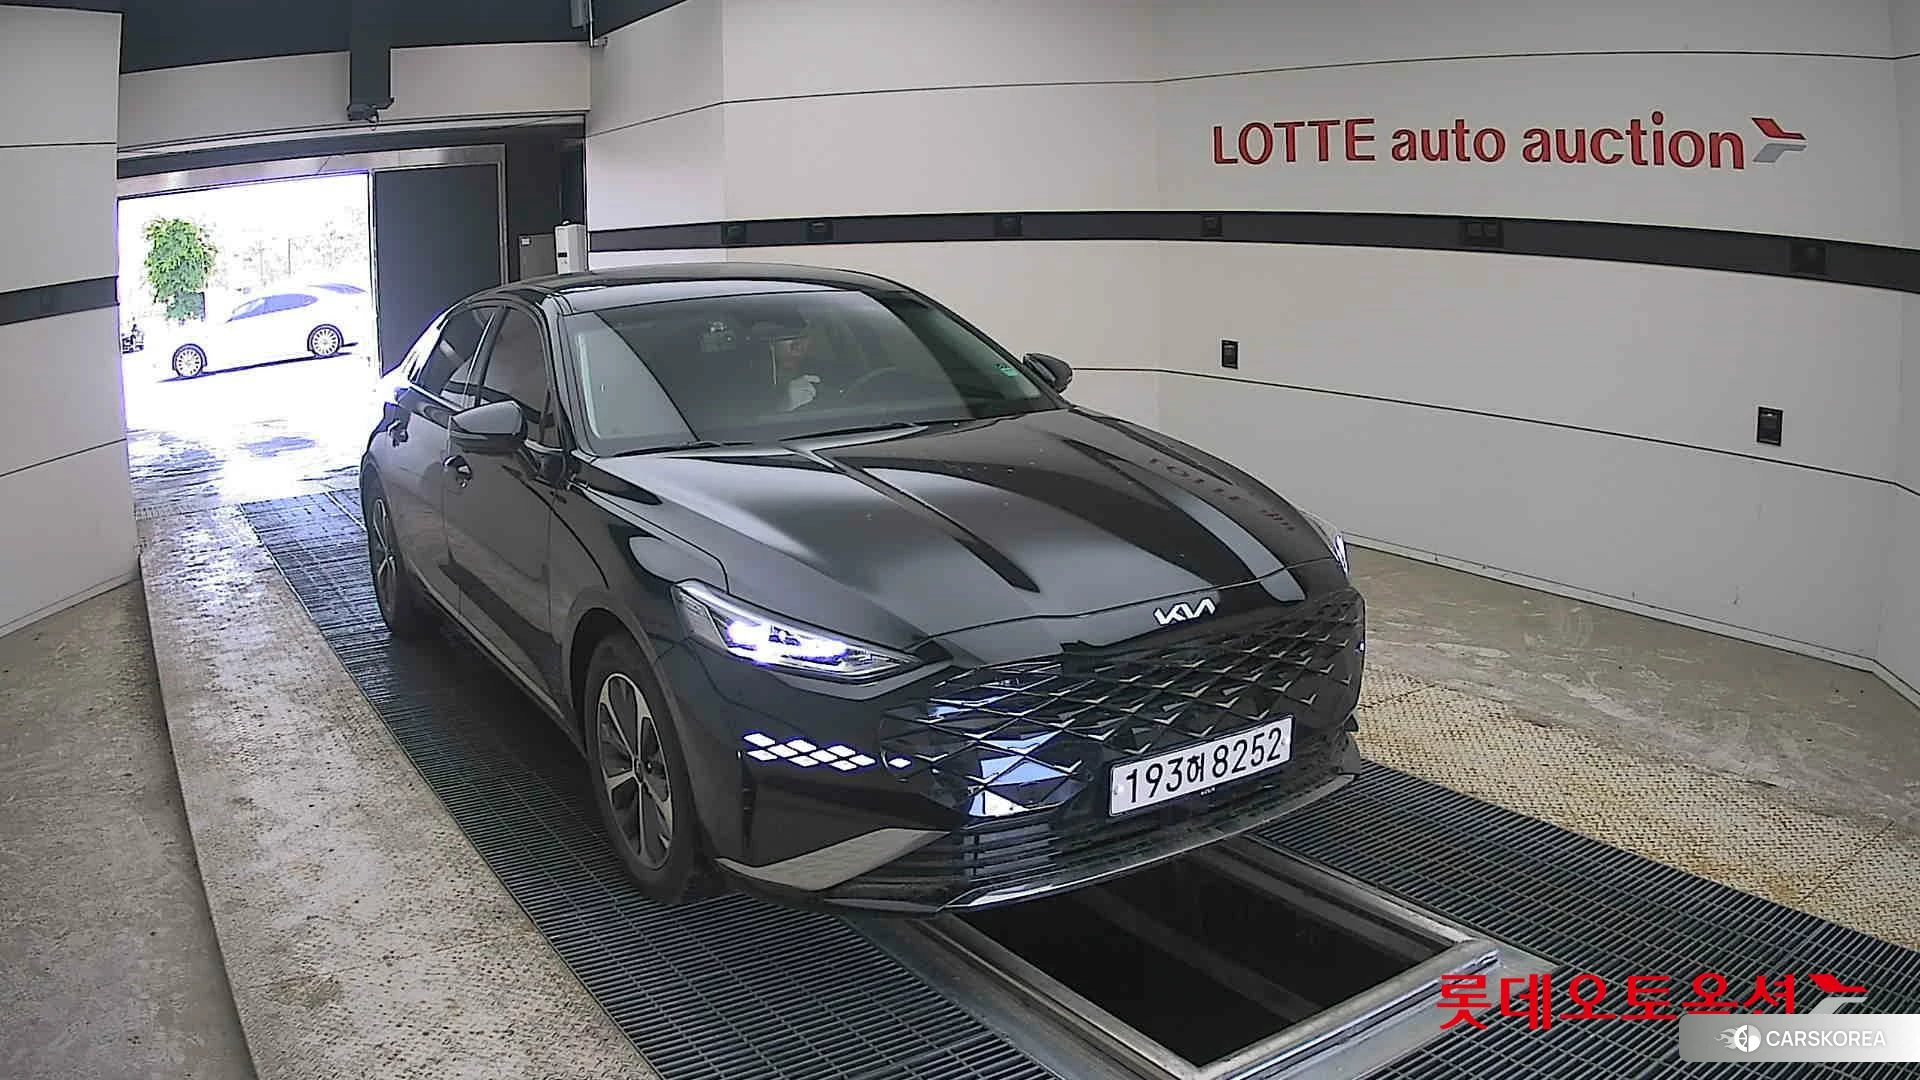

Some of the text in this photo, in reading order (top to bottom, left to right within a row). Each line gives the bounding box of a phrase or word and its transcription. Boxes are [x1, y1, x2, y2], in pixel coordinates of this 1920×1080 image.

[1213, 111, 1745, 170] LOTTE auto auction
